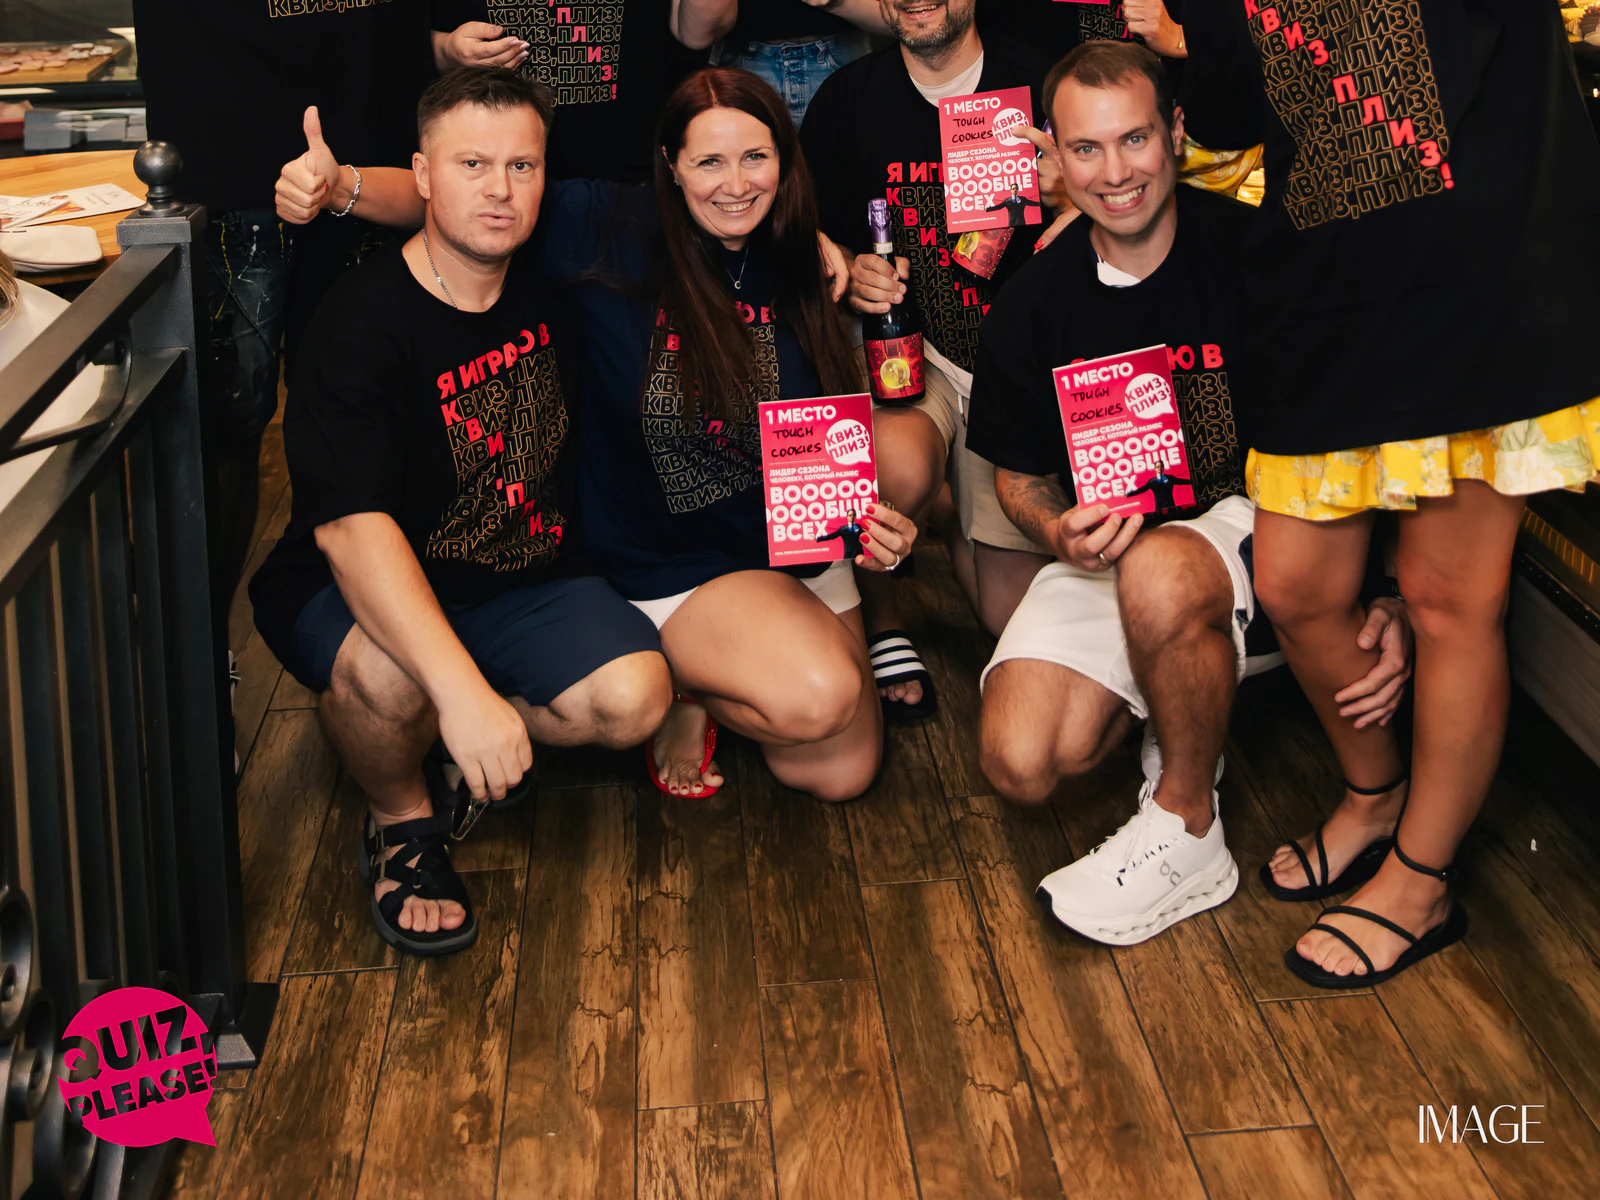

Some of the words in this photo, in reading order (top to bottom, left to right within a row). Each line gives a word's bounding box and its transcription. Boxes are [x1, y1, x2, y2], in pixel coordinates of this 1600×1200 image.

[944, 103, 951, 115] 1
[953, 97, 1001, 114] МЕСТО
[953, 117, 985, 127] TOUGH
[992, 112, 1026, 132] КВИЗ,
[995, 121, 1029, 141] ПЛ!
[947, 150, 969, 159] ЛИДЕР
[970, 146, 996, 156] СЕЗОНА
[886, 162, 902, 182] Я
[944, 173, 1032, 198] ОООБЩЕ
[950, 193, 995, 213] ВСЕХ
[437, 370, 456, 400] Я
[538, 323, 550, 346] В
[1202, 343, 1223, 369] В
[1061, 375, 1070, 390] 1
[1073, 362, 1134, 389] МЕСТО
[1070, 387, 1110, 403] TOUGH
[1125, 376, 1168, 402] КВИЗ,
[1130, 387, 1170, 414] ПЛИЗ!
[766, 410, 774, 425] 1
[778, 404, 837, 424] МЕСТО
[773, 426, 813, 439] TOUGH
[826, 424, 867, 447] КВИЗ,
[1071, 428, 1099, 441] ЛИДЕР
[1099, 420, 1133, 435] СЕЗОНА
[1107, 427, 1138, 440] КОТОРЫЙ
[1138, 421, 1163, 433] РАЗНЕС
[828, 436, 870, 459] ПЛИЗ!
[1074, 428, 1185, 468] ВООООО
[770, 467, 797, 477] ЛИДЕР
[798, 465, 830, 475] СЕЗОНА
[804, 471, 835, 481] КОТОРЫЙ
[835, 469, 859, 477] РАЗНЕС
[770, 478, 878, 505] ВООООО
[1081, 474, 1138, 504] ВСЕХ
[766, 497, 872, 524] ОООБЩЕ
[773, 520, 828, 542] ВСЕХ
